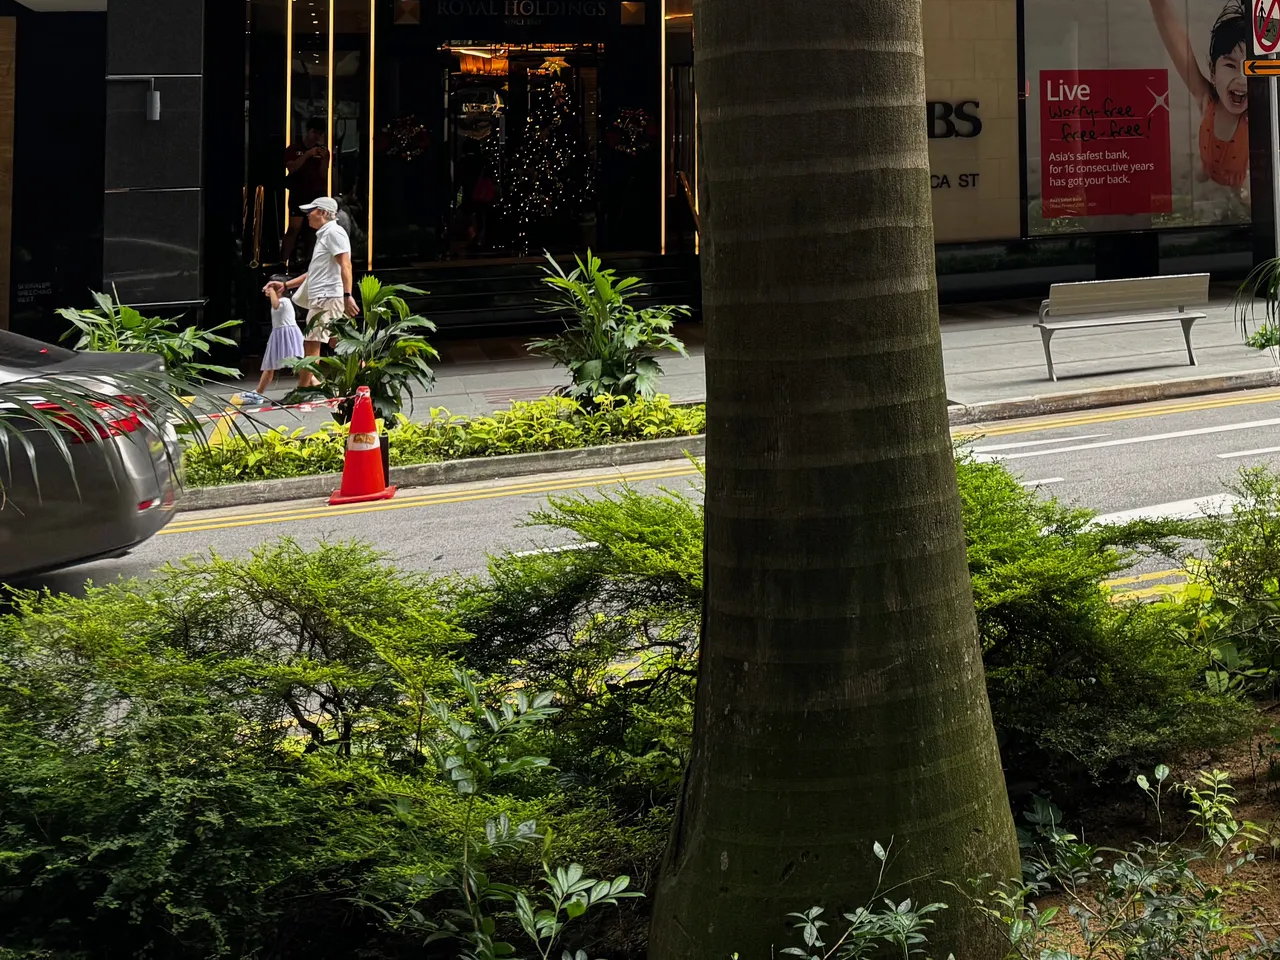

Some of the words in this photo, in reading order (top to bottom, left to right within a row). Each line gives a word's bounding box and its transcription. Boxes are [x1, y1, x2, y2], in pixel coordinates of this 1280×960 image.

[437, 0, 498, 16] ROYAL
[503, 0, 607, 16] HOLDINGS
[1047, 79, 1090, 101] Live
[1049, 152, 1074, 161] Asia's
[1076, 150, 1103, 160] safest
[1105, 149, 1130, 160] bank,
[1049, 164, 1063, 174] for
[1064, 164, 1075, 173] 16
[1076, 162, 1128, 173] consecutive
[1130, 163, 1154, 173] years
[958, 173, 980, 188] ST
[1049, 177, 1066, 186] has
[1067, 177, 1083, 188] got
[1084, 177, 1105, 187] your
[1107, 174, 1131, 184] back.
